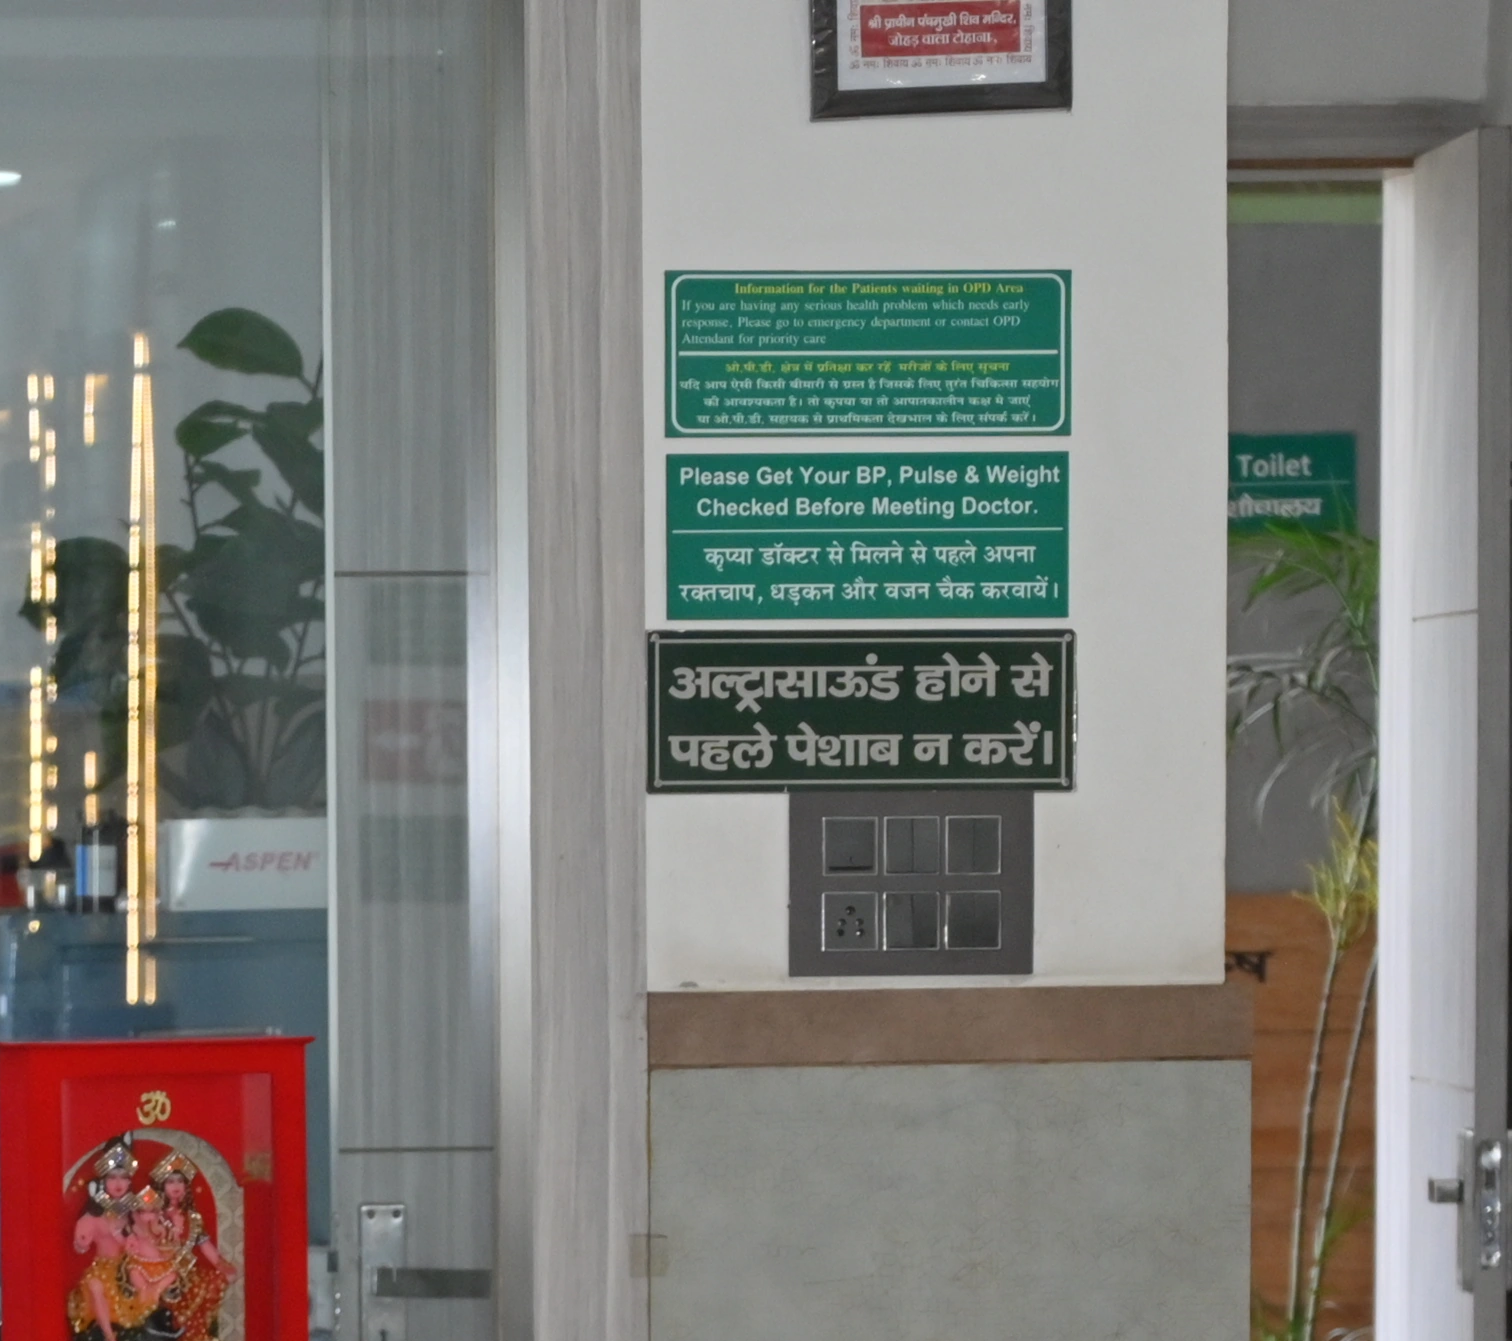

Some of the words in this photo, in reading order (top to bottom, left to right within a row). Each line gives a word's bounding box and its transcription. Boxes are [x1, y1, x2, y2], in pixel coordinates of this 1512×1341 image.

[735, 283, 804, 294] Information
[808, 283, 825, 294] for
[829, 283, 848, 294] the
[852, 283, 897, 293] Patients
[902, 283, 944, 296] waiting
[948, 283, 959, 293] in
[963, 283, 991, 293] OPD
[995, 283, 1024, 293] Area
[682, 300, 691, 311] If
[695, 302, 715, 313] you
[719, 302, 736, 311] are
[740, 300, 777, 313] having
[780, 302, 800, 313] any
[804, 300, 842, 311] serious
[846, 300, 879, 311] health
[882, 300, 928, 313] problem
[932, 299, 964, 310] which
[968, 300, 999, 310] needs
[1003, 300, 1030, 312] early
[737, 316, 776, 327] Please
[776, 319, 790, 330] go
[793, 318, 804, 327] to
[808, 318, 866, 329] emergency
[871, 316, 931, 329] department
[951, 317, 989, 326] contact
[993, 316, 1021, 326] OPD
[682, 333, 734, 344] Attendant
[738, 333, 755, 344] for
[758, 333, 800, 347] priority
[803, 336, 826, 344] care
[856, 363, 873, 372] कर
[936, 361, 947, 371] के
[951, 361, 974, 373] लिए
[978, 362, 1010, 374] सूचना
[680, 378, 700, 391] यदि
[705, 380, 727, 389] आप
[731, 378, 752, 392] ऐसी
[756, 378, 785, 389] किसी
[789, 378, 824, 389] बीमारी
[829, 378, 839, 389] से
[868, 378, 877, 390] है
[879, 378, 915, 389] जिसके
[919, 378, 942, 391] लिए
[971, 378, 1017, 388] चिकित्सा
[1022, 377, 1059, 389] सहयोग
[703, 396, 719, 407] की
[724, 398, 785, 406] आवश्यकता
[808, 395, 819, 406] तो
[824, 398, 855, 409] कृपया
[860, 398, 872, 406] या
[877, 395, 888, 405] तो
[893, 395, 964, 405] आपातकालीन
[968, 397, 991, 405] कक्ष
[697, 415, 709, 424] या
[769, 415, 809, 424] सहायक
[813, 412, 823, 424] से
[936, 412, 948, 422] के
[951, 412, 975, 424] लिए
[1236, 452, 1313, 478] Toilet
[680, 467, 750, 487] Please
[756, 466, 794, 486] Get
[799, 466, 850, 486] Your
[856, 466, 893, 489] BP,
[899, 465, 958, 485] Pulse
[964, 465, 980, 484] &
[986, 464, 1060, 488] Weight
[696, 498, 789, 517] Checked
[795, 498, 865, 516] Before
[871, 497, 955, 520] Meeting
[962, 496, 1038, 516] Doctor.
[703, 548, 753, 572] कृप्या
[759, 541, 821, 565] डॉक्टर
[827, 541, 845, 564] से
[850, 541, 903, 564] मिलने
[910, 541, 927, 564] से
[933, 540, 977, 565] पहले
[984, 546, 1036, 564] अपना
[679, 584, 763, 605] रक्तचाप,
[770, 582, 835, 606] धड़कन
[842, 576, 878, 601] और
[884, 582, 931, 600] वजन
[937, 576, 975, 600] चैक
[668, 653, 904, 714] अल्ट्रासाऊंड
[915, 652, 1001, 702] होने
[1011, 652, 1054, 700] से
[668, 722, 777, 771] पहले
[784, 722, 903, 768] पेशाब
[913, 734, 953, 767] न
[209, 851, 313, 872] ASPEN
